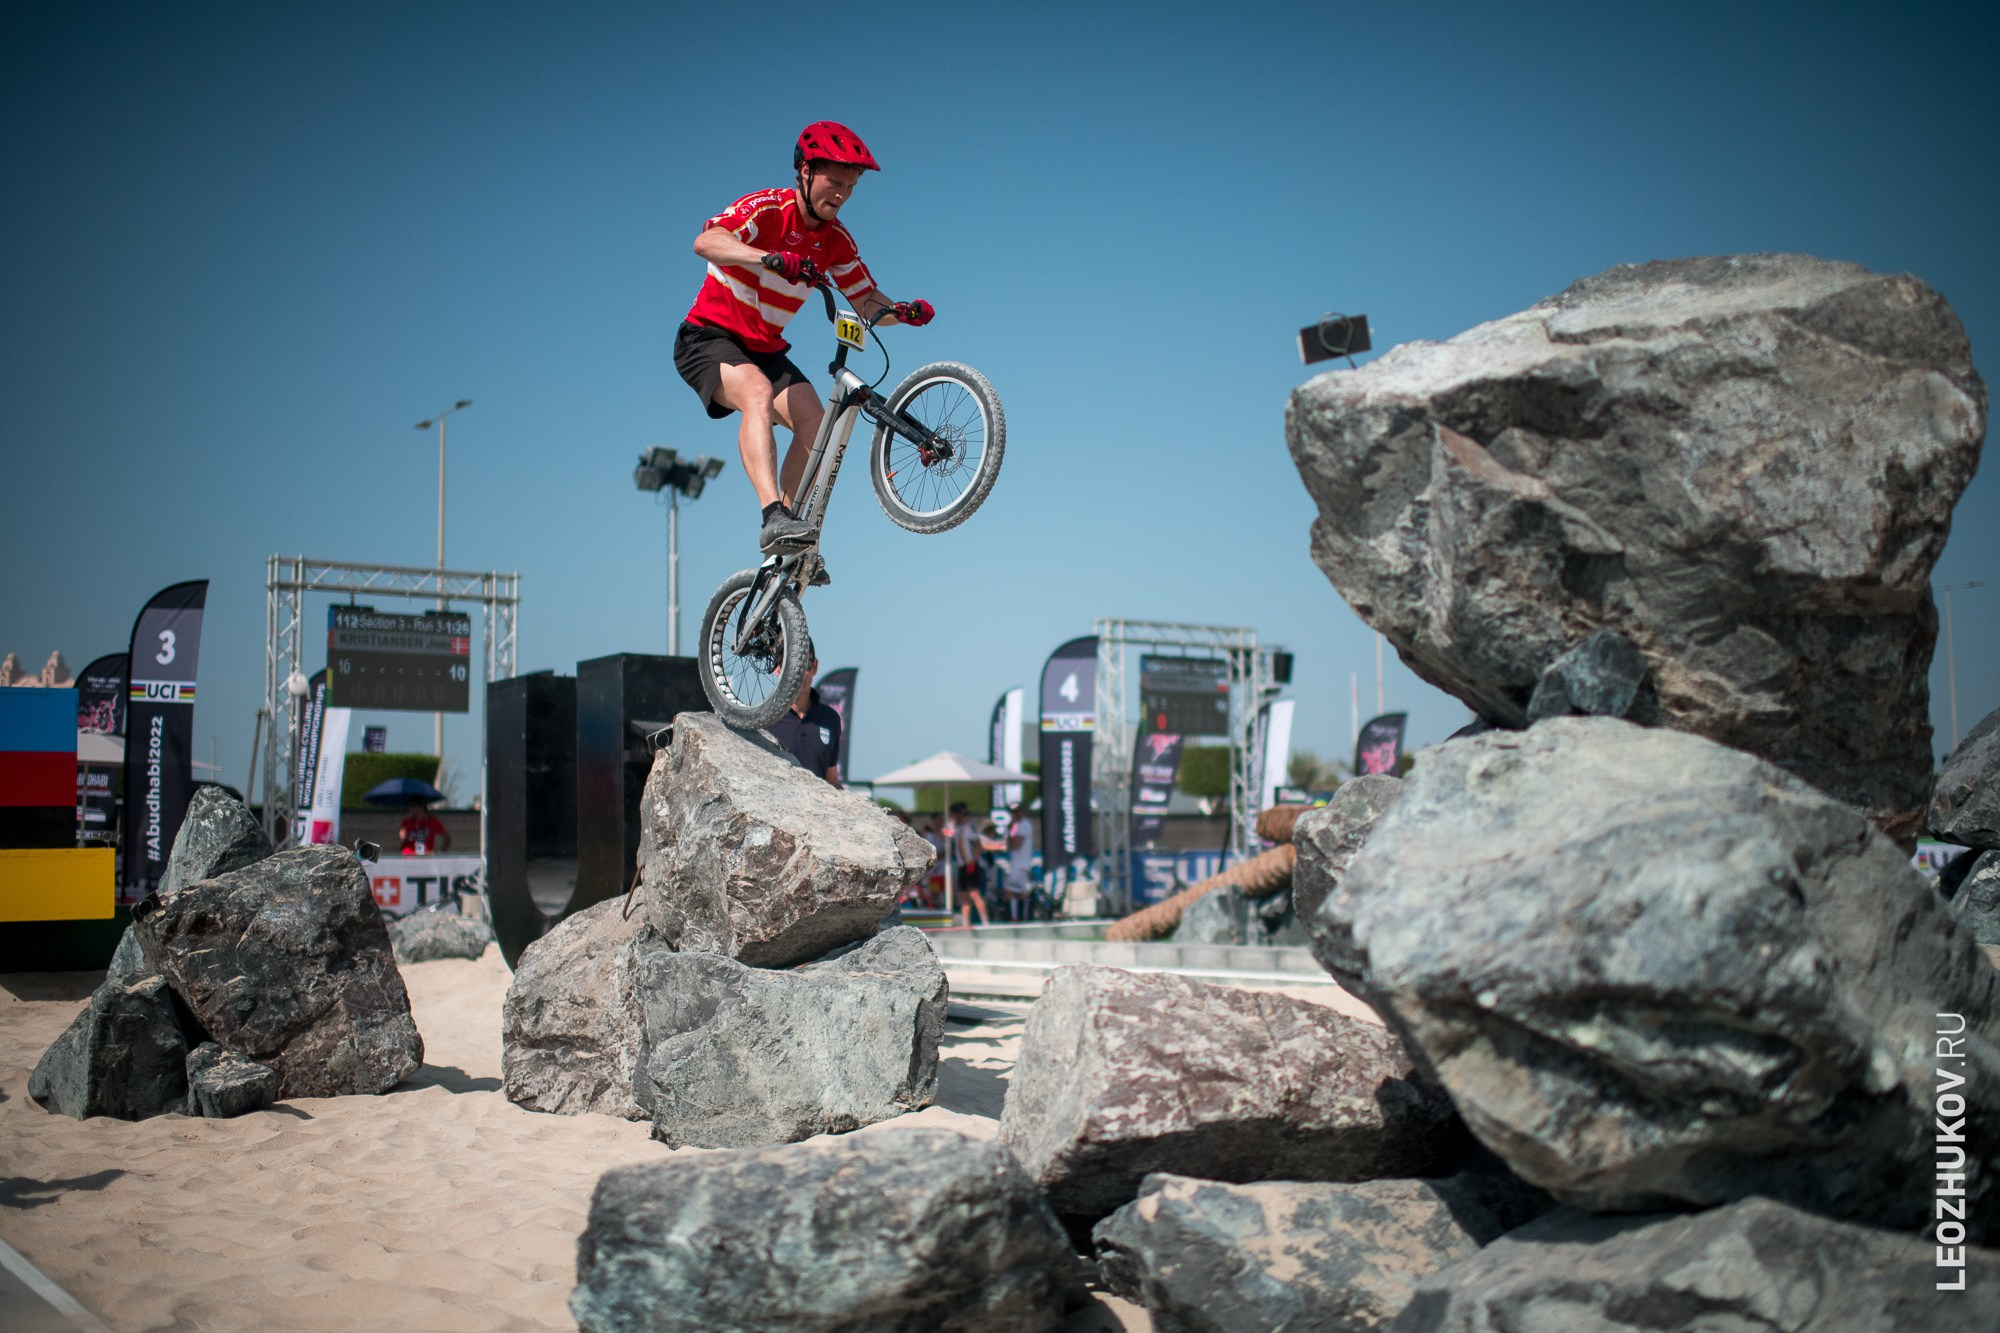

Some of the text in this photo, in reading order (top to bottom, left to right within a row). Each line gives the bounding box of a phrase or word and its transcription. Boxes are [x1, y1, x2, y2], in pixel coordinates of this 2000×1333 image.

[842, 323, 861, 344] 112
[863, 399, 909, 434] MAESTRO
[336, 614, 358, 630] 112
[359, 615, 396, 632] Section
[155, 628, 176, 666] 3
[449, 664, 467, 682] 10
[146, 683, 177, 700] UCI
[1059, 672, 1080, 704] 4
[301, 700, 315, 746] CYCLING
[1055, 716, 1081, 730] UCI
[303, 682, 326, 806] WORLD CHAMPIONSHIPS
[87, 773, 109, 788] DHABI
[145, 715, 164, 862] #Abudhabi2022
